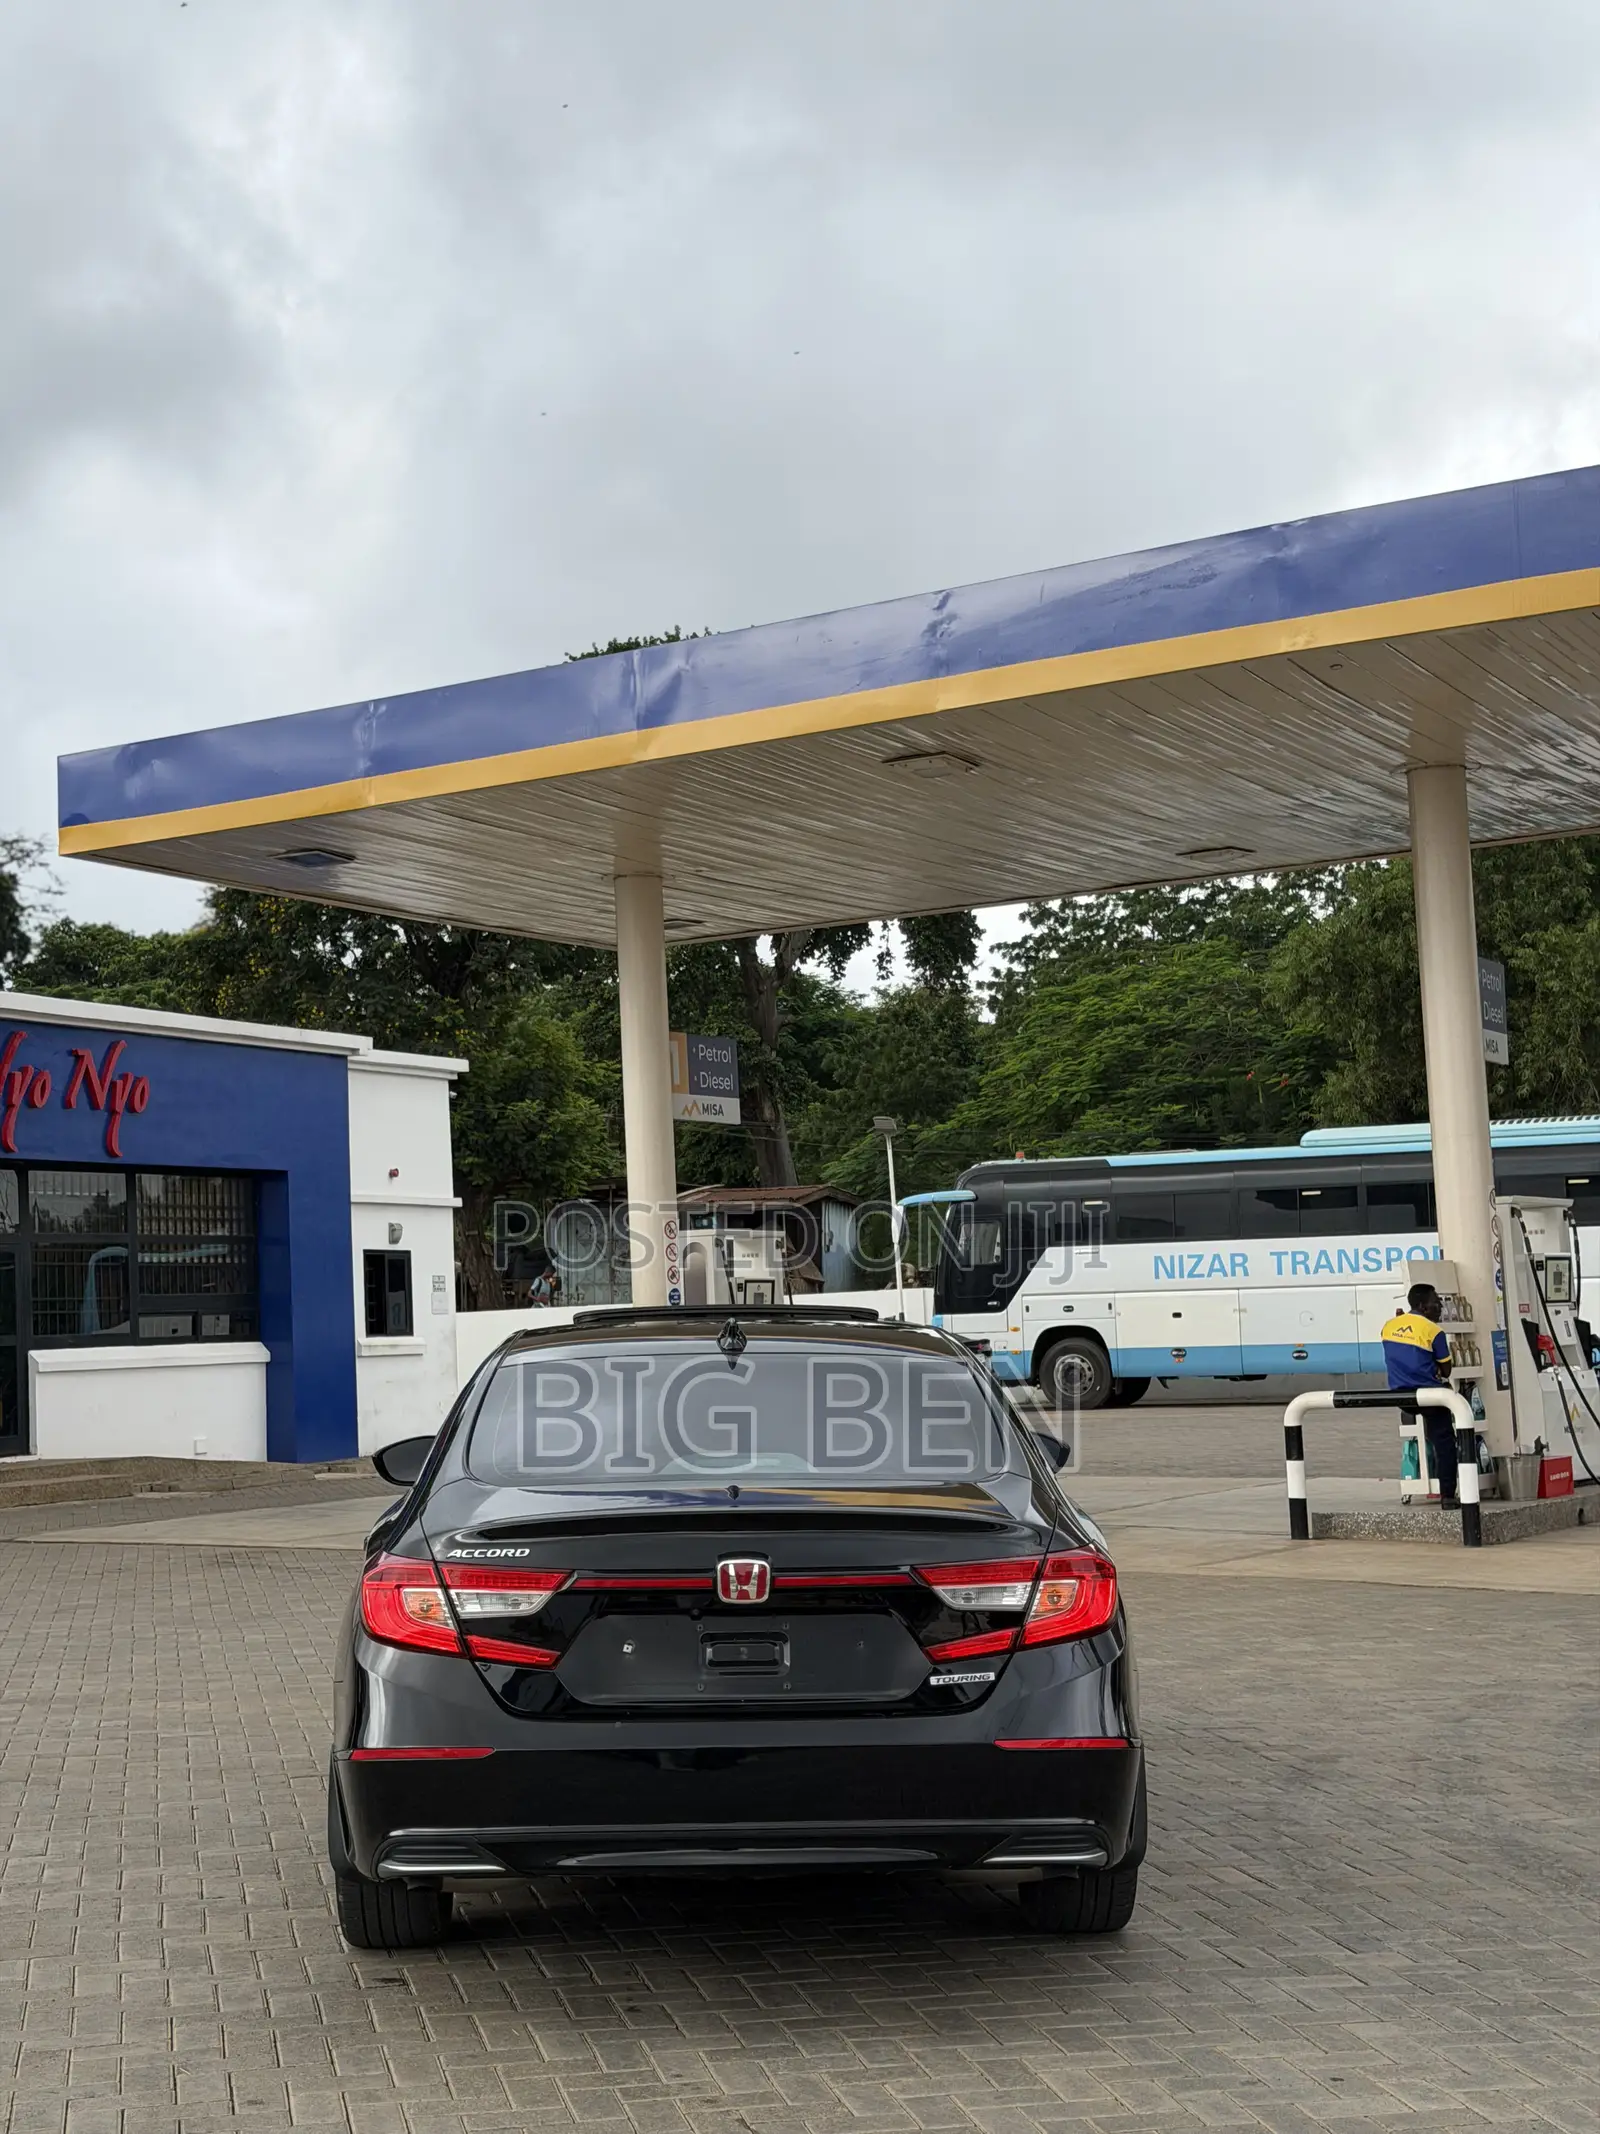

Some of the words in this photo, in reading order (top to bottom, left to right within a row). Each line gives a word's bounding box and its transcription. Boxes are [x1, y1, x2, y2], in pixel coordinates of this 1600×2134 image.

[698, 1044, 732, 1064] Petrol
[700, 1071, 734, 1091] Diesel
[65, 1040, 150, 1158] Nyo
[702, 1103, 724, 1116] MISA
[1153, 1252, 1250, 1280] NIZAR
[447, 1548, 530, 1558] ACCORD
[935, 1674, 991, 1684] TOURING
